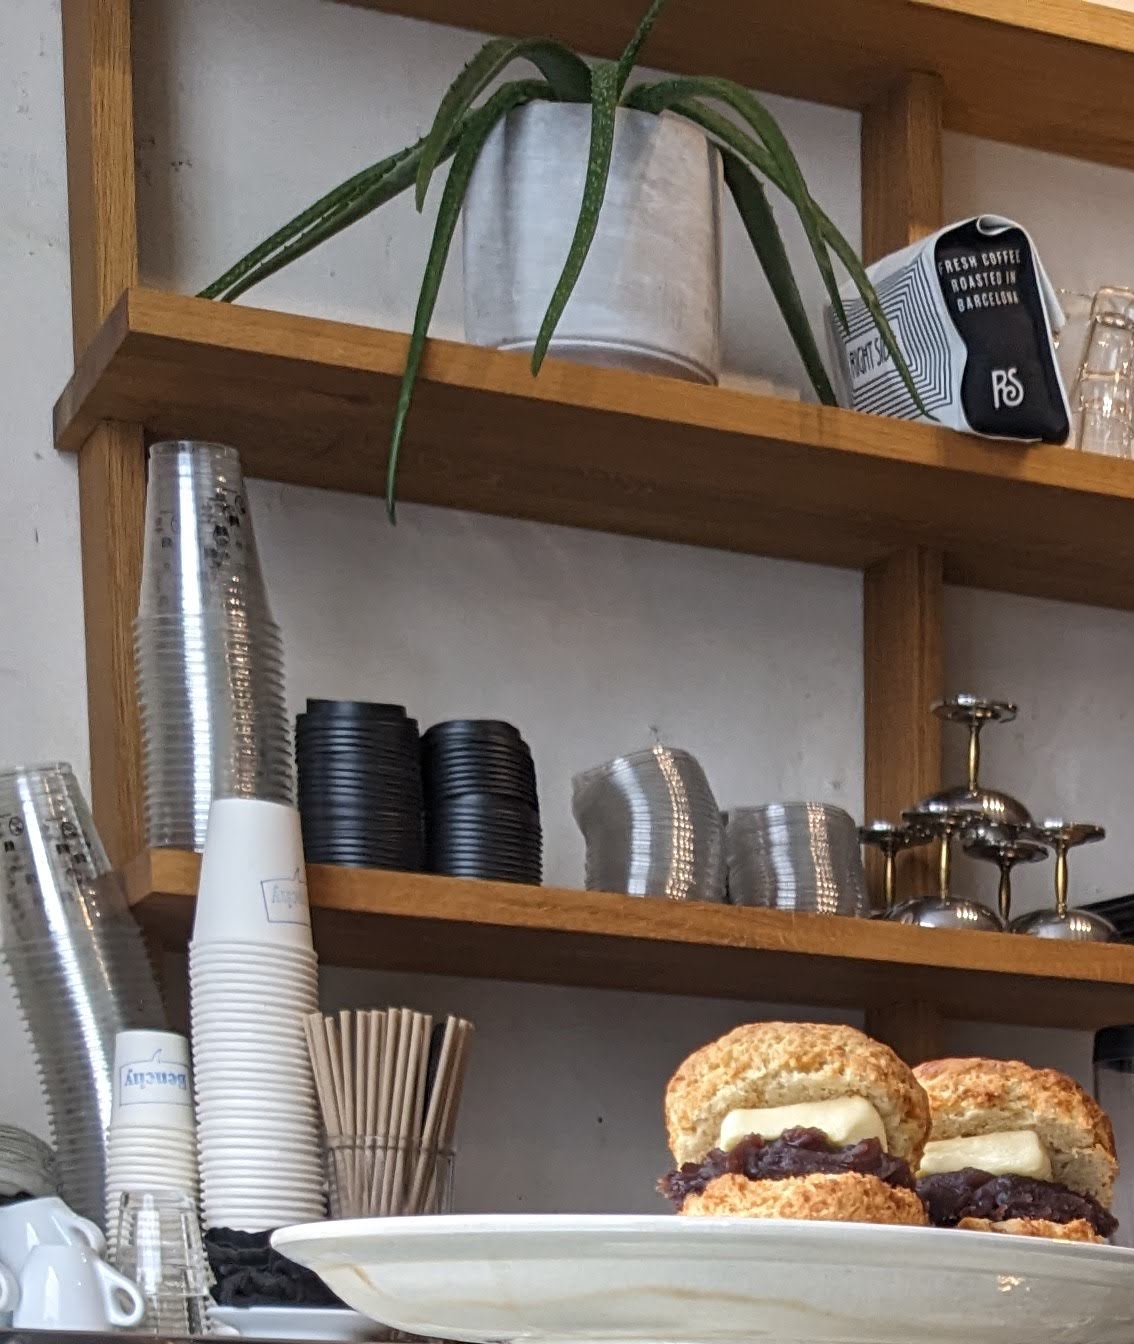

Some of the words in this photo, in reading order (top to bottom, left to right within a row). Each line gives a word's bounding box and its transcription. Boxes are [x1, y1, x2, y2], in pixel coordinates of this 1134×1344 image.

[938, 256, 978, 276] FRESH
[982, 248, 1021, 266] COFFEE
[951, 273, 1003, 293] ROASTED
[1005, 271, 1016, 286] IN
[956, 292, 1019, 313] BARCELONA
[991, 367, 1025, 411] RS
